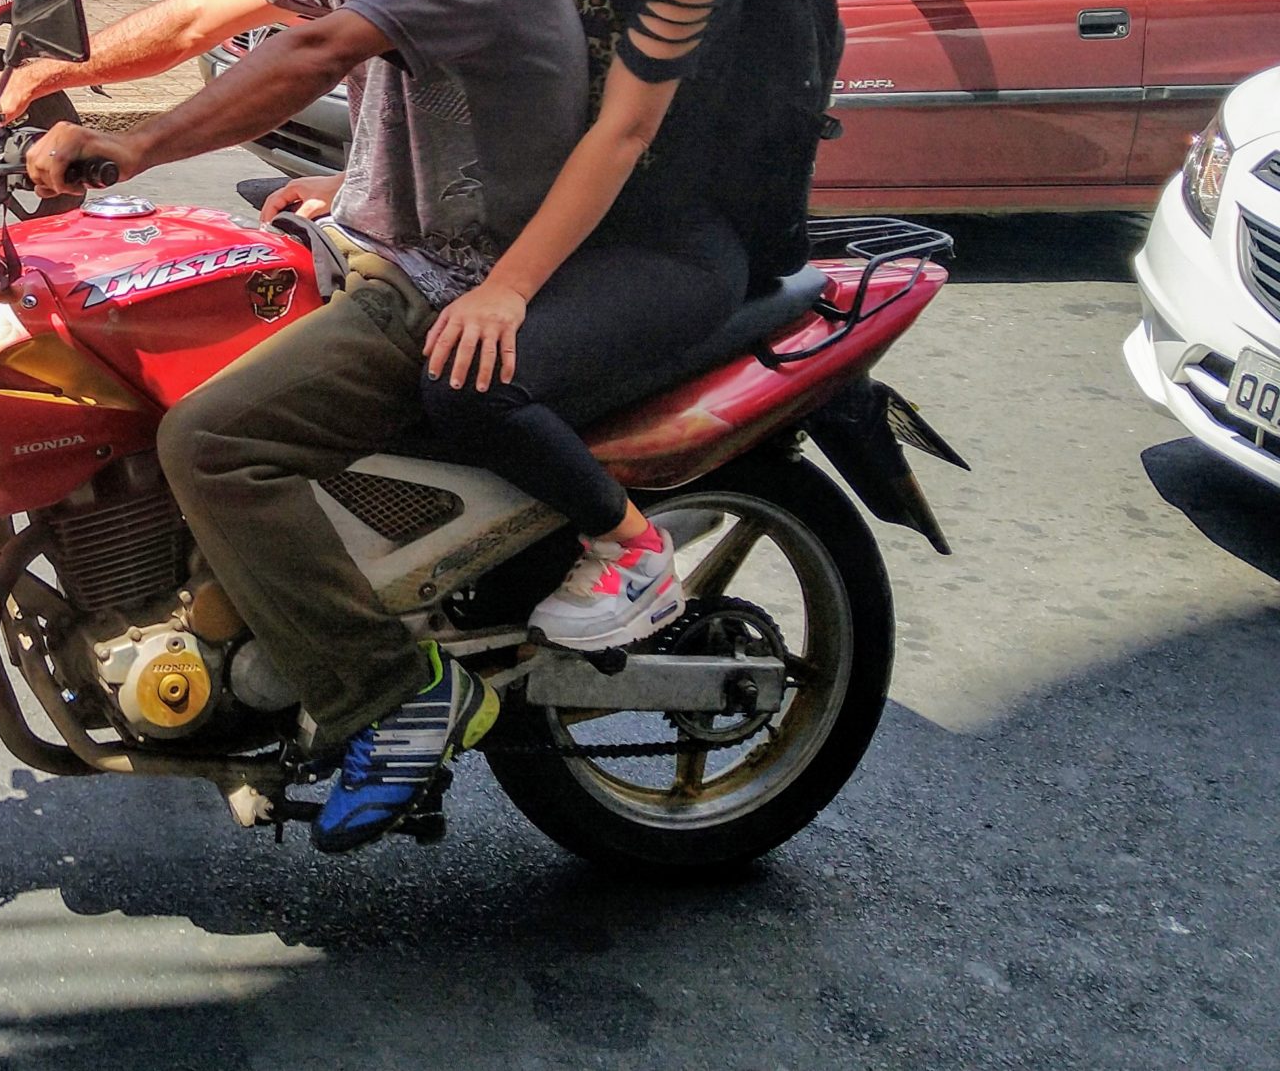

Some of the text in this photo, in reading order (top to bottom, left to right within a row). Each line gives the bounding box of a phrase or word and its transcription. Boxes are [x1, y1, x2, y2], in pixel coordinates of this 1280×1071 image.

[1235, 373, 1280, 427] QQ
[12, 434, 86, 456] HONDA
[152, 662, 202, 673] HONDA
